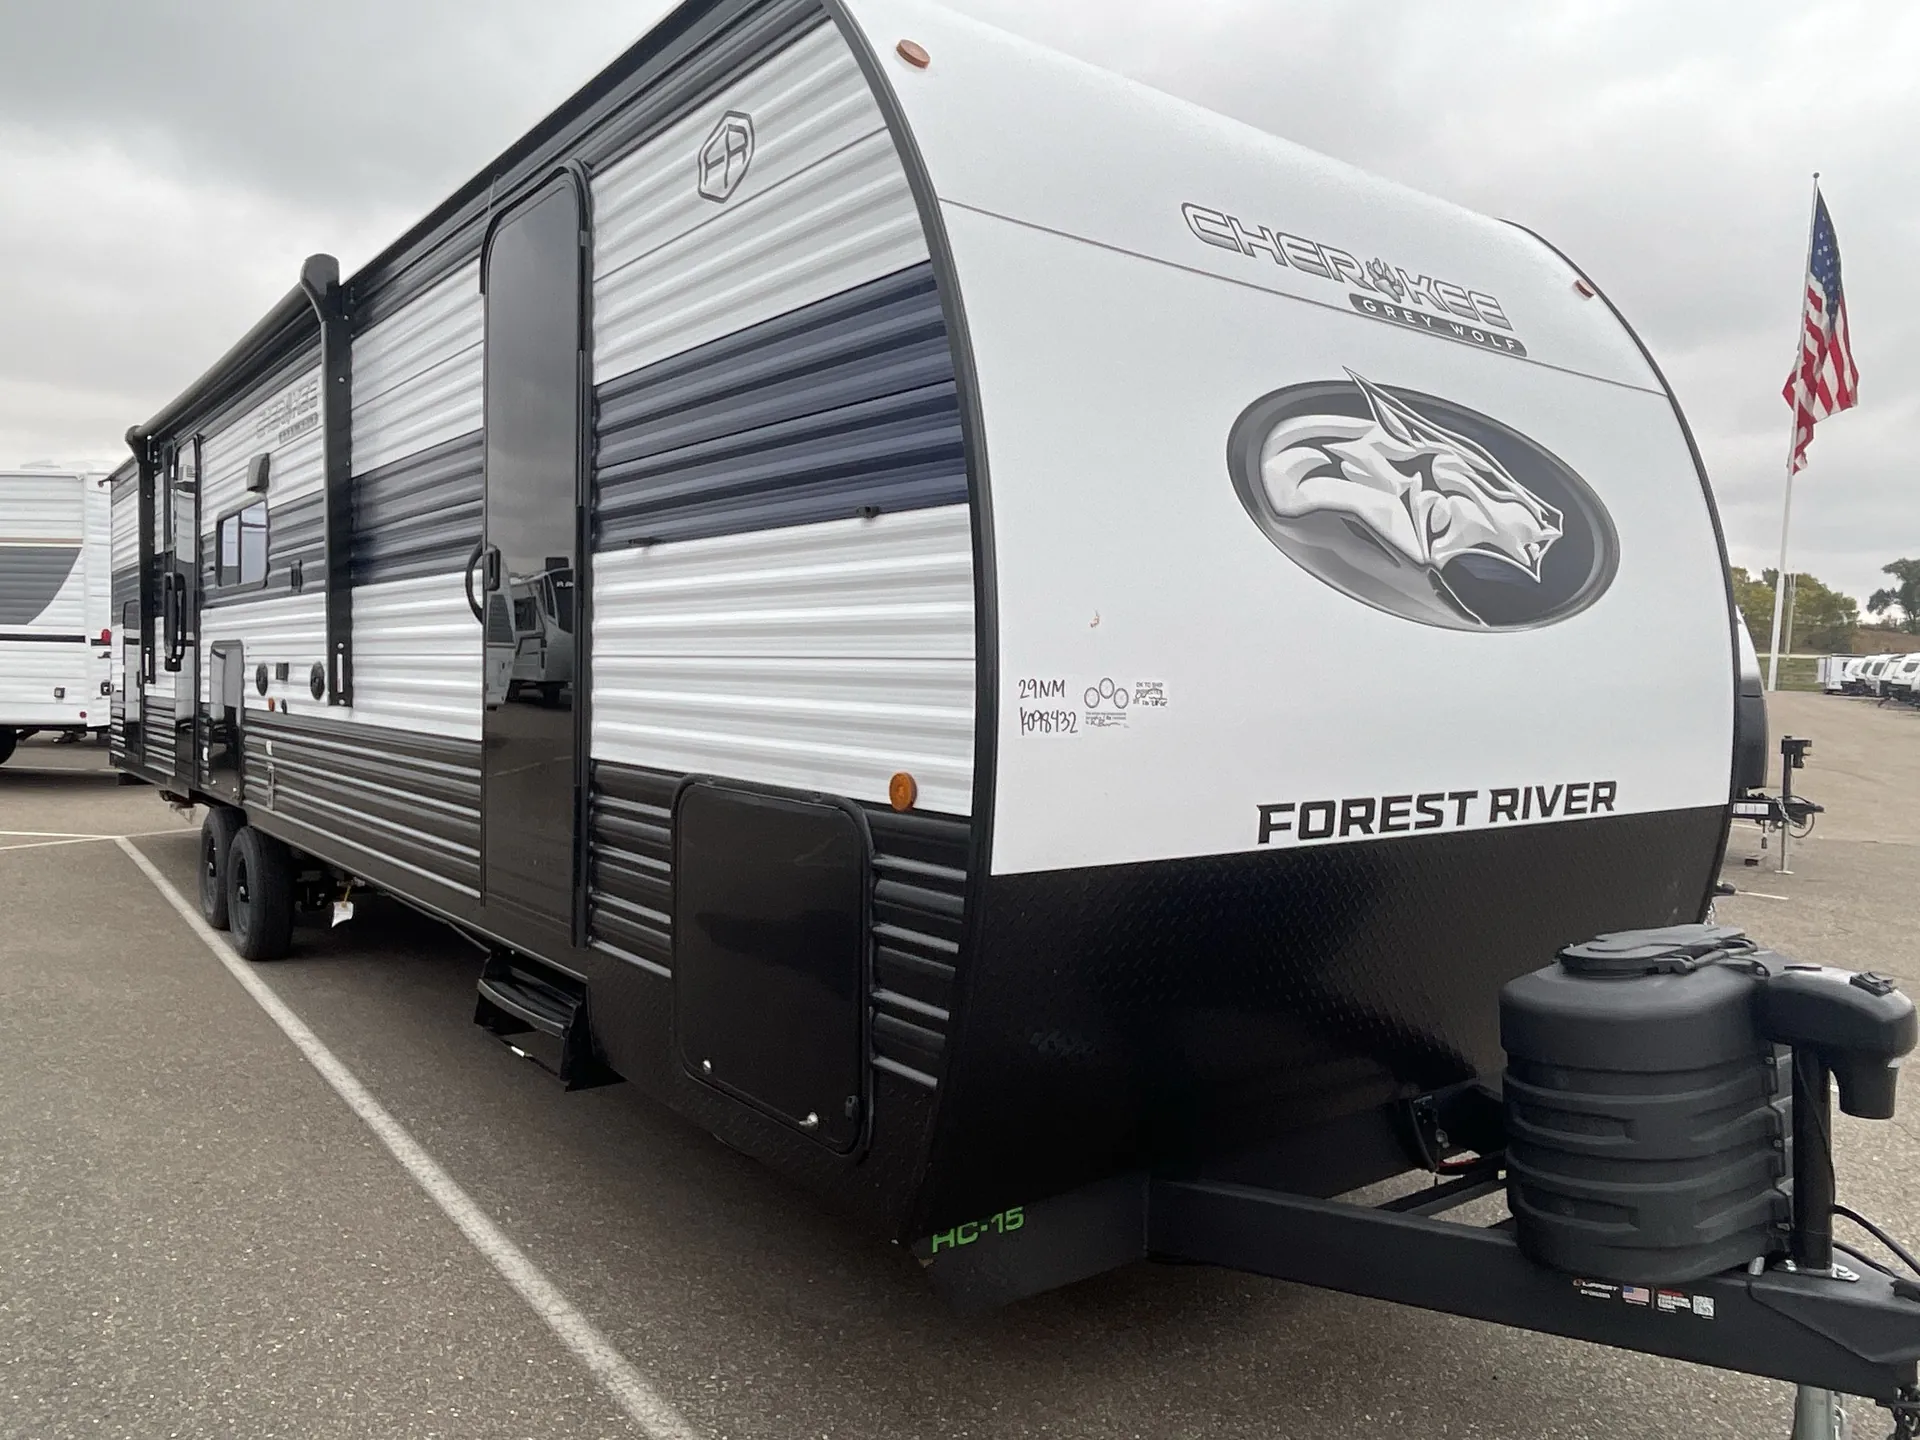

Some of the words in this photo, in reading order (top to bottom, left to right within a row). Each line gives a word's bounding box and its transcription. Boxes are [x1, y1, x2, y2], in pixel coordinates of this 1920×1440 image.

[1362, 299, 1432, 328] GREY
[1450, 323, 1515, 351] WOLF
[1018, 678, 1065, 699] 29NM
[1256, 790, 1478, 844] FOREST
[1489, 781, 1617, 823] RIVER
[932, 1206, 1024, 1253] HC-15
